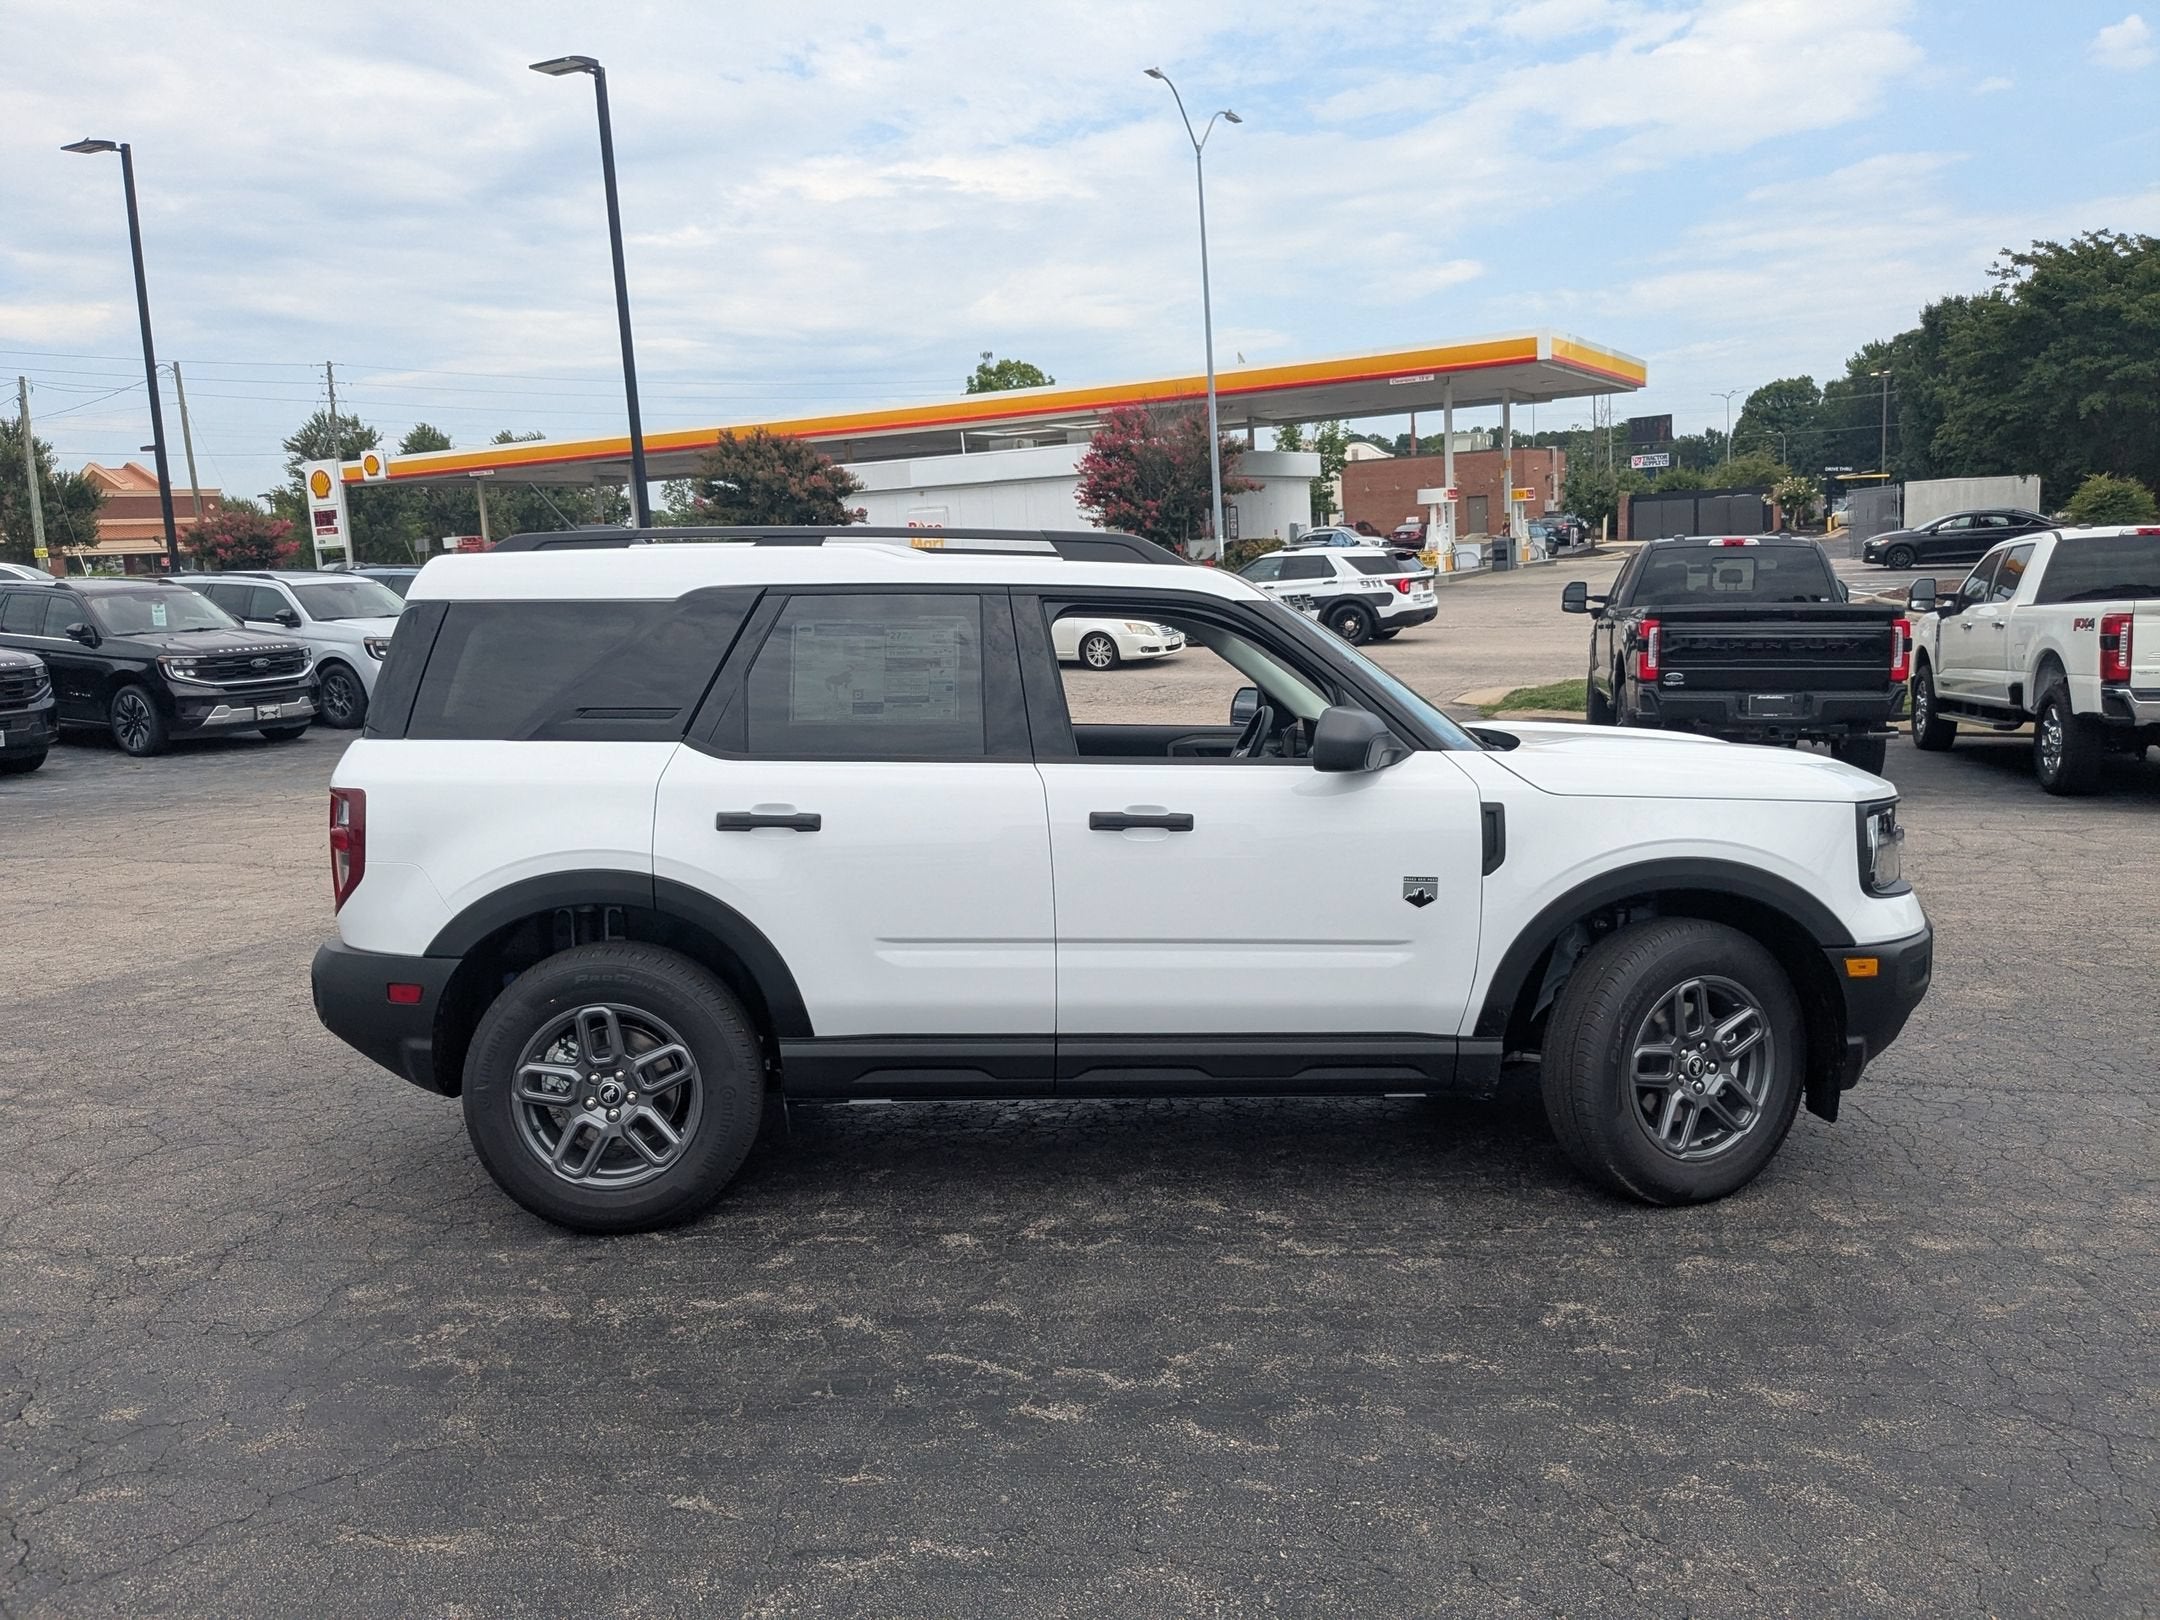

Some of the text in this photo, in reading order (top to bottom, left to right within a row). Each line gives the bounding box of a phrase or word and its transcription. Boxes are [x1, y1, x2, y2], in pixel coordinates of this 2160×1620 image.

[1642, 454, 1668, 462] TRACTOR
[1360, 580, 1383, 589] 911
[2073, 618, 2095, 631] FX4
[218, 644, 288, 653] EXPEDITION
[1691, 641, 1860, 650] SUPER DUTY
